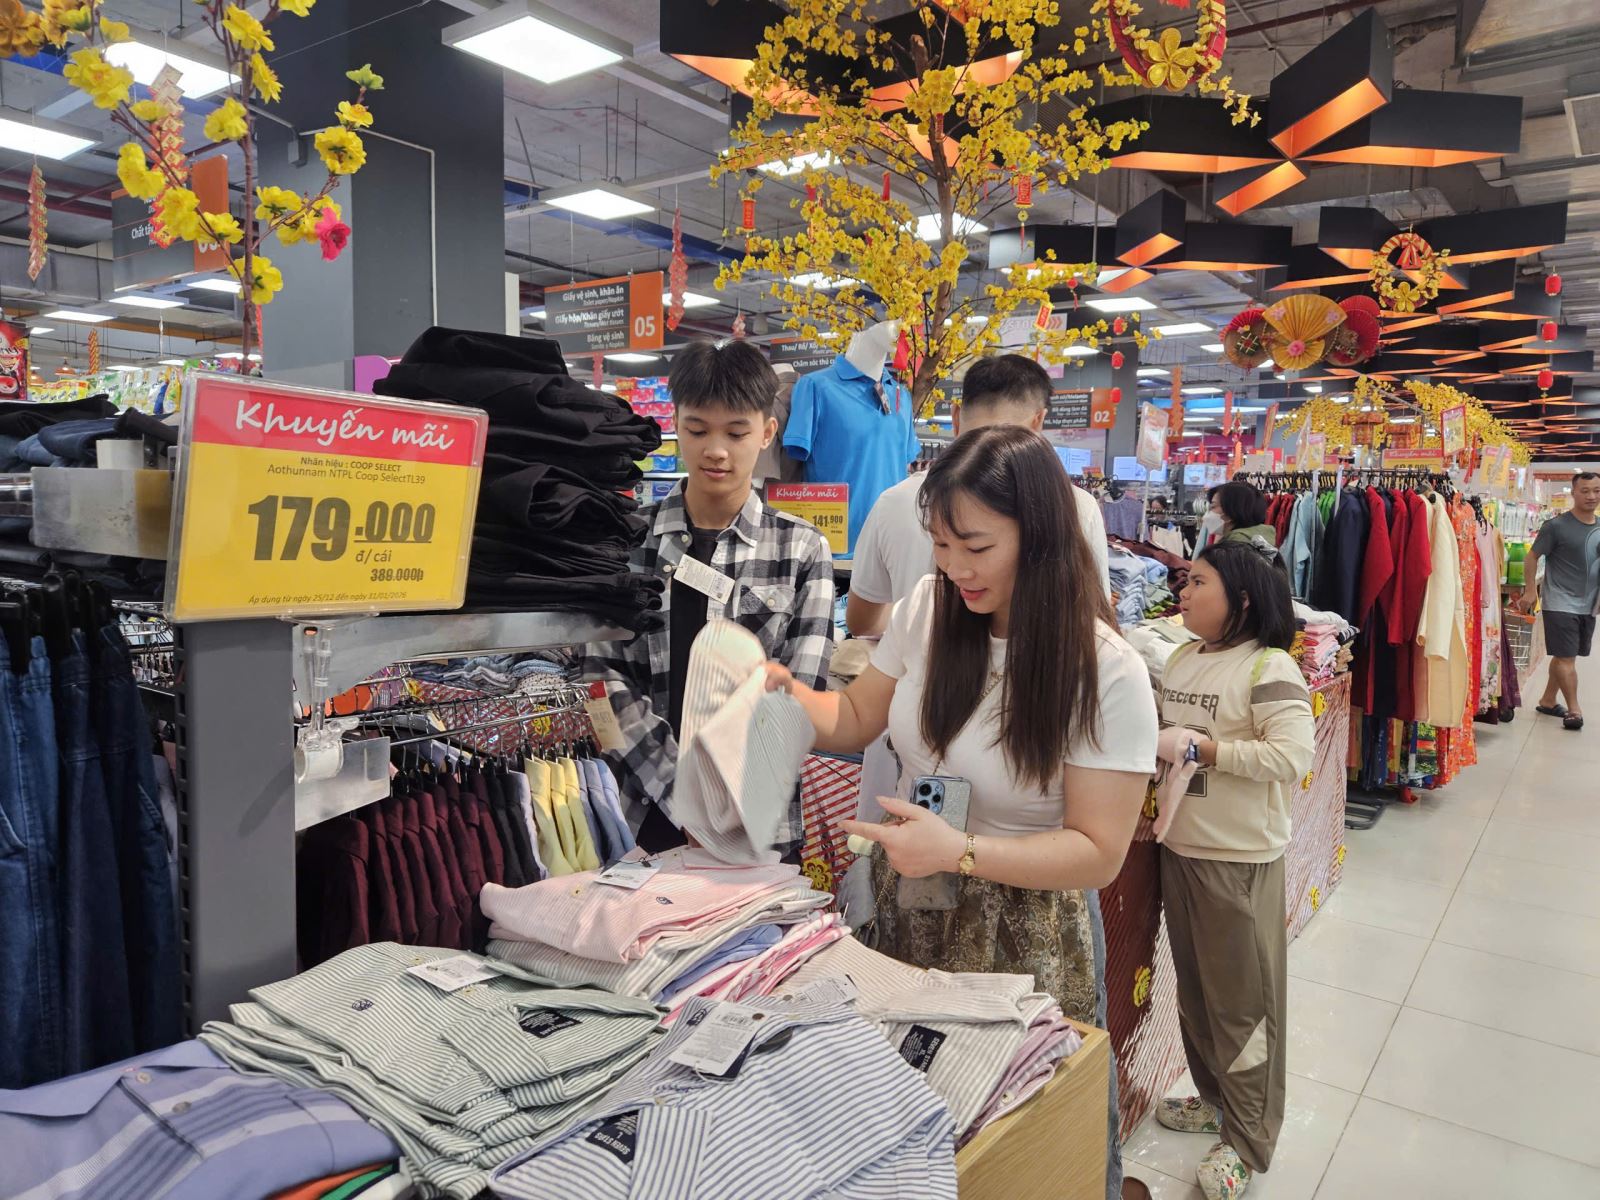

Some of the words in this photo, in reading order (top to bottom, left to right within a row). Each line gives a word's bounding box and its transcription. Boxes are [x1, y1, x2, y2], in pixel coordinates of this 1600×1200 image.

[562, 292, 575, 302] Giấy
[634, 315, 656, 337] 05
[1094, 410, 1110, 422] 02
[235, 400, 385, 446] Khuyến
[391, 422, 454, 450] mãi
[300, 457, 323, 467] Nhãn
[325, 457, 343, 469] hiệu
[350, 461, 374, 471] COOP
[375, 463, 401, 472] SELECT
[268, 464, 327, 479] Aothunnam
[329, 469, 352, 479] NTPL
[355, 471, 378, 482] Coop
[776, 487, 815, 499] Khuyến
[817, 487, 839, 497] mãi
[812, 514, 843, 528] 141.900
[373, 549, 392, 563] cái
[260, 595, 281, 605] dụng
[282, 594, 291, 602] từ
[293, 594, 311, 604] ngày
[312, 593, 334, 602] 25/12
[350, 592, 367, 602] ngày
[610, 1139, 631, 1155] SEVEN
